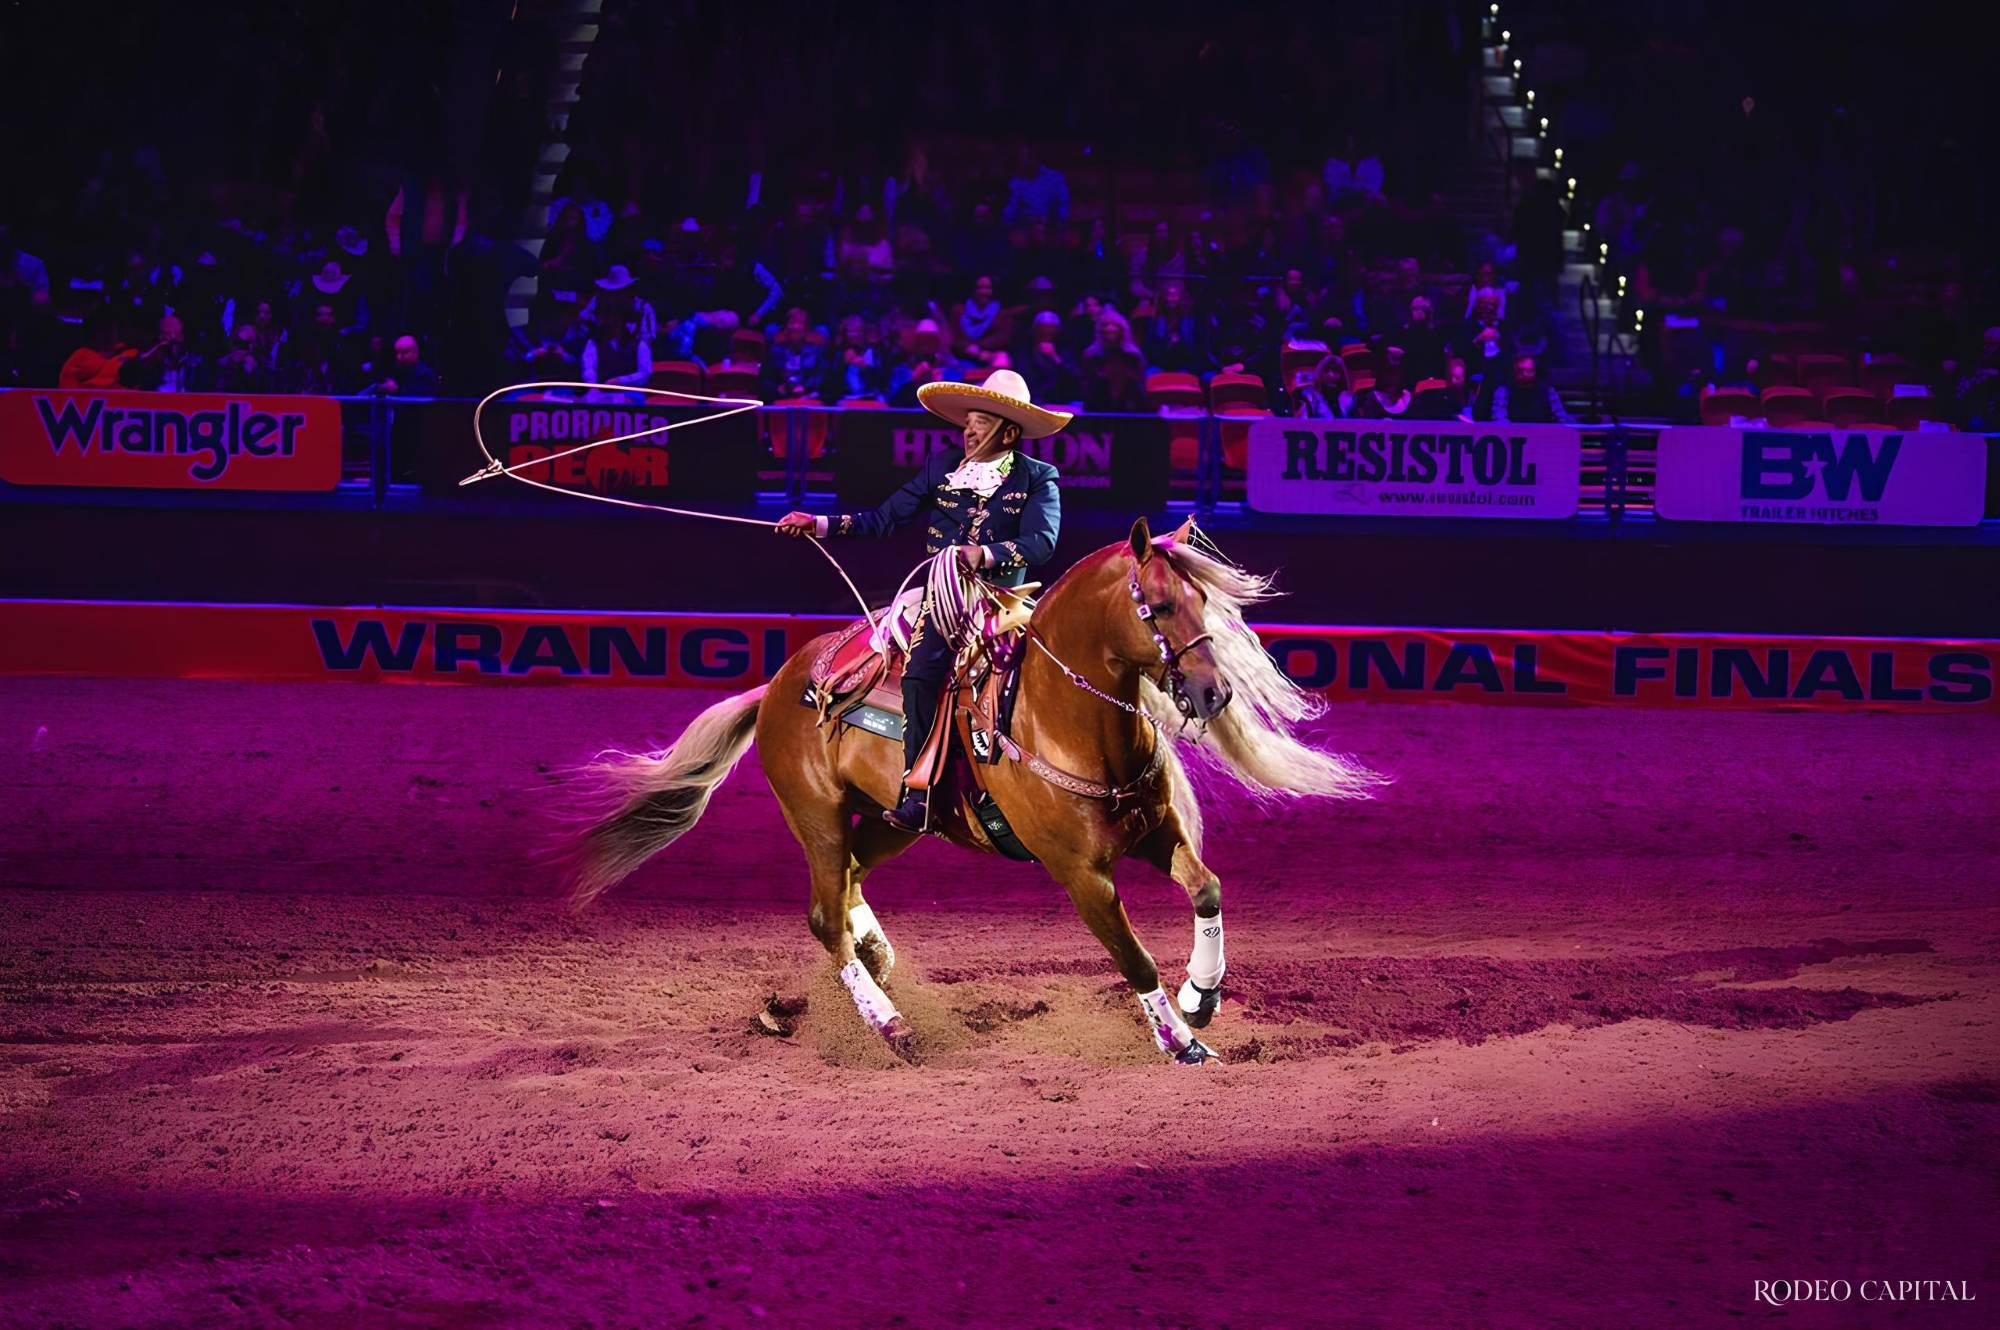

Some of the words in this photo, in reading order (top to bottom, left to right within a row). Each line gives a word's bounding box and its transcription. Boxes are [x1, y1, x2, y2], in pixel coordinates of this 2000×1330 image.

[32, 396, 305, 481] Wrangler
[1282, 430, 1536, 485] RESISTOL
[1740, 505, 1806, 520] TRAILER
[1810, 507, 1879, 521] HITCHES
[1265, 638, 1567, 693] ONAL
[1613, 646, 1992, 703] FINALS
